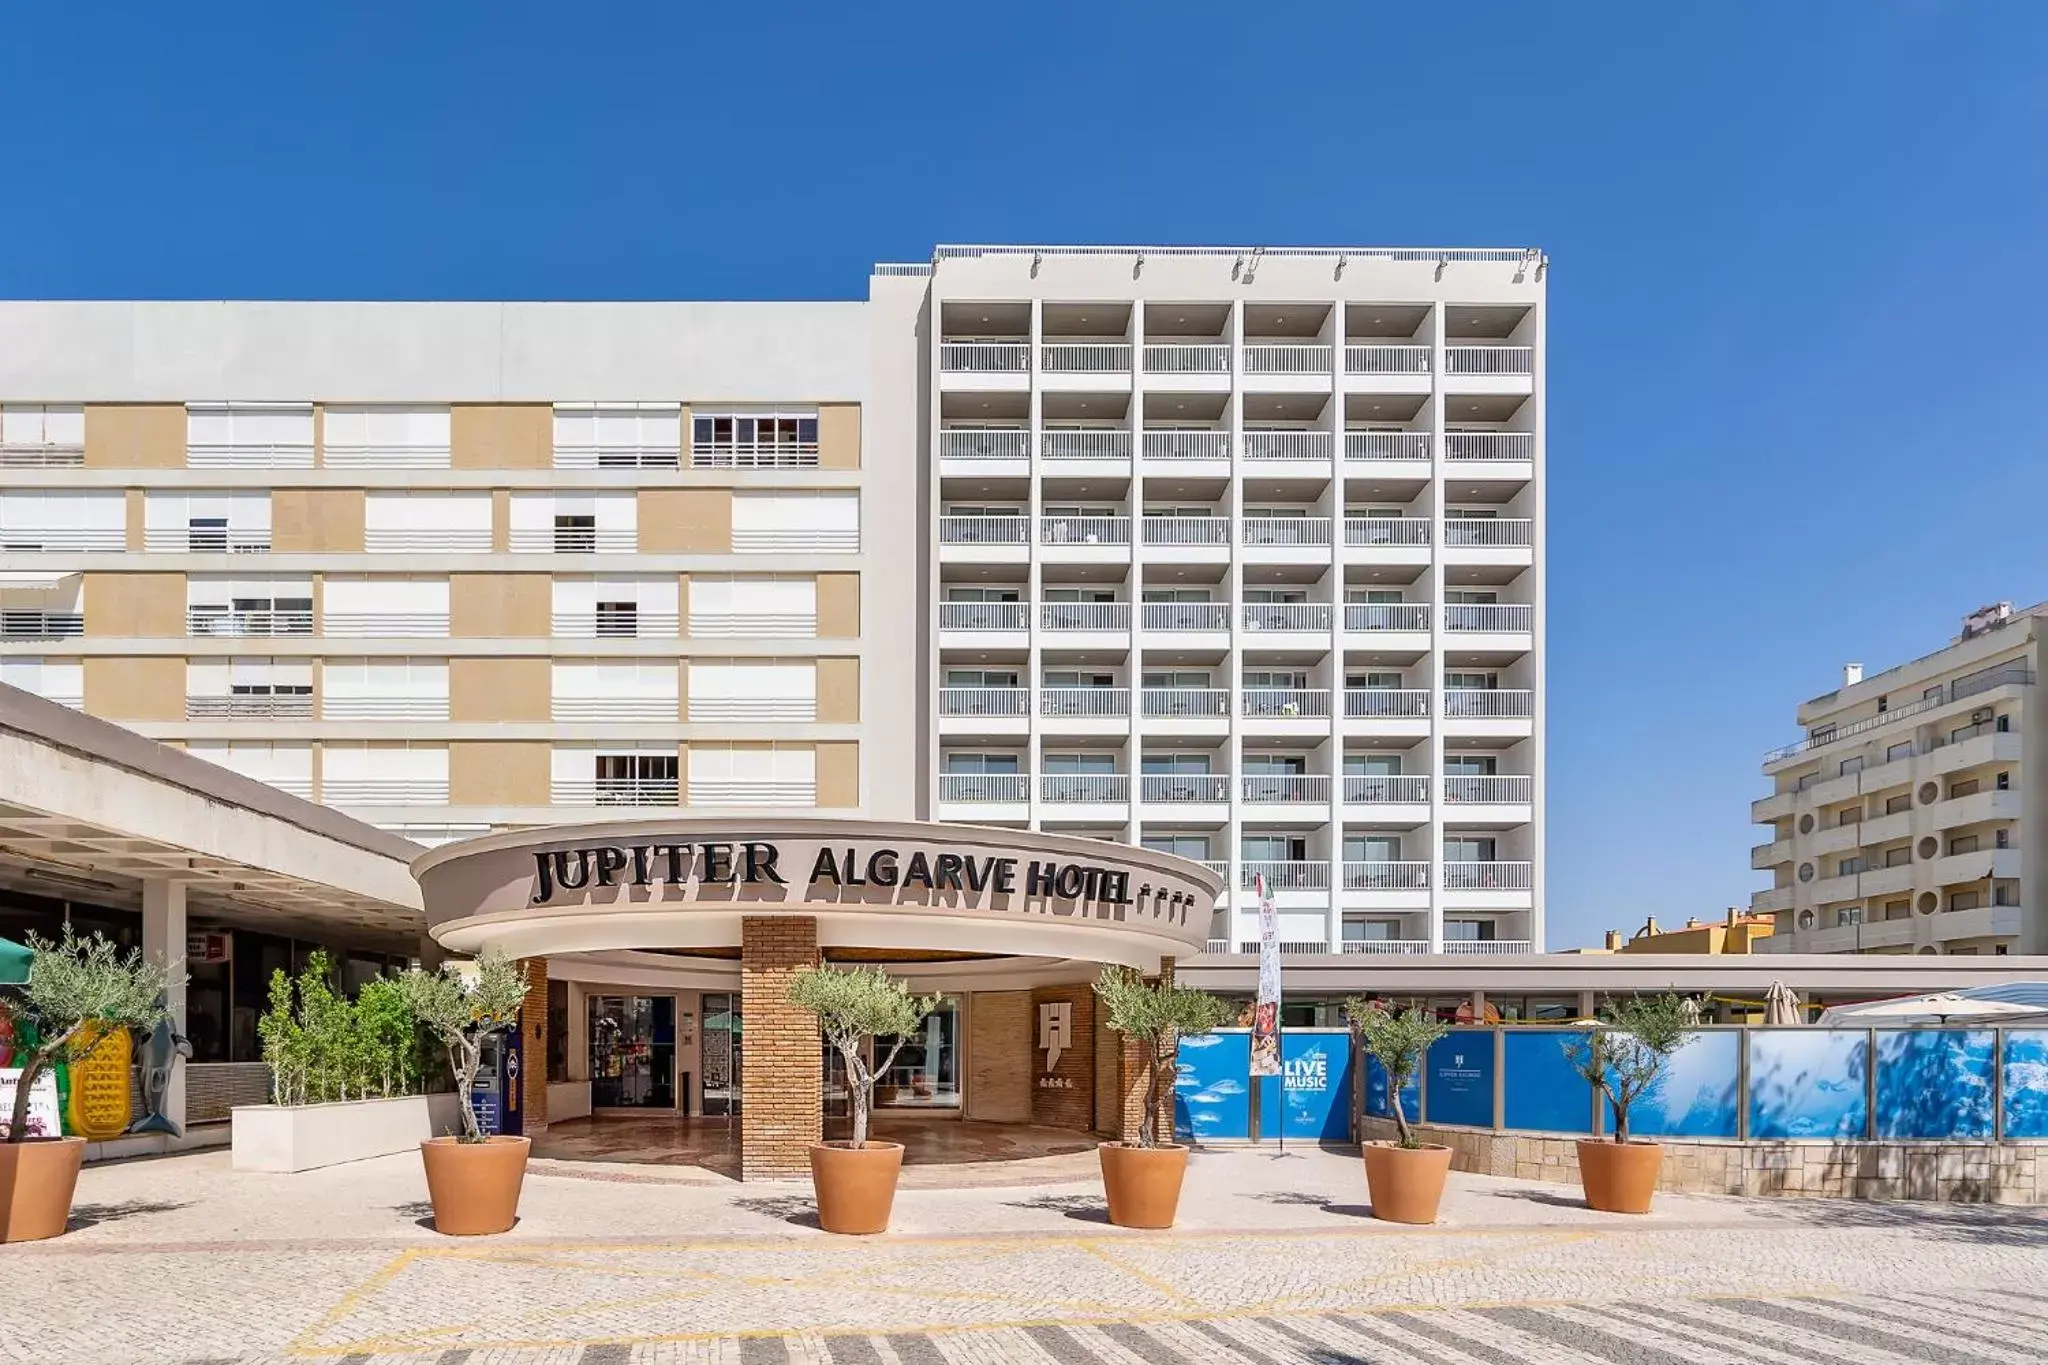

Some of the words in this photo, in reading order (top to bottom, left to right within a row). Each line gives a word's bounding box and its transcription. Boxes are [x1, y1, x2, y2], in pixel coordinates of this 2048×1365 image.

[532, 842, 790, 903] JUPITER
[809, 847, 1017, 894] ALGARVE
[1026, 861, 1133, 904] HOTEL
[1284, 1060, 1327, 1077] LIVE
[1284, 1077, 1328, 1087] MUSIC
